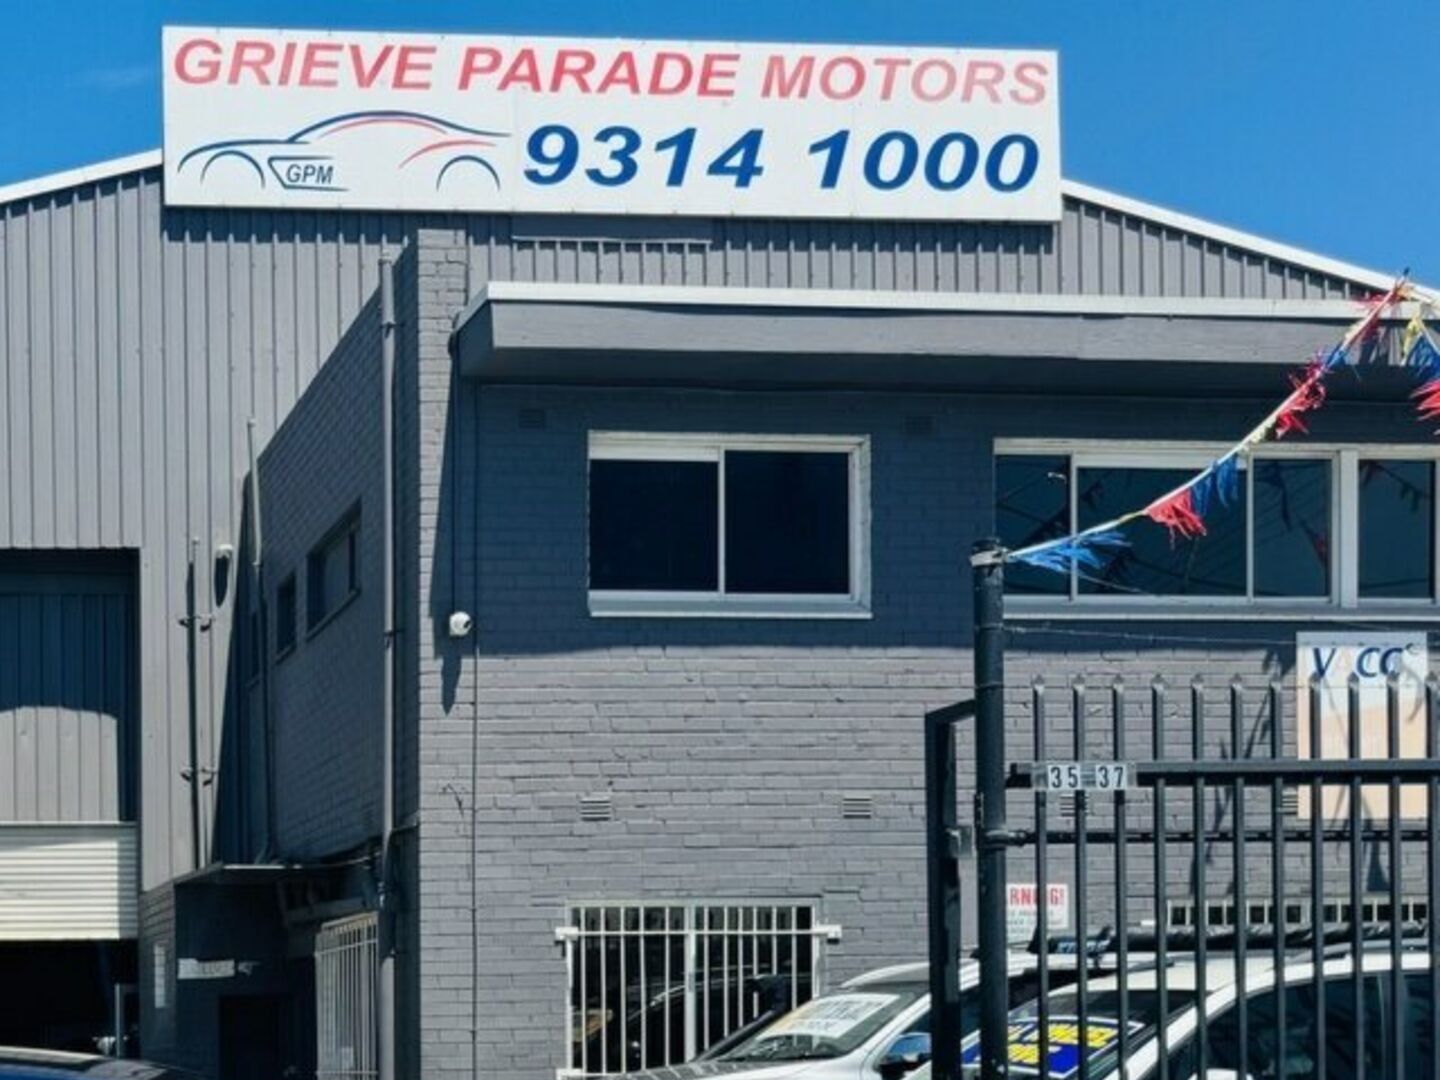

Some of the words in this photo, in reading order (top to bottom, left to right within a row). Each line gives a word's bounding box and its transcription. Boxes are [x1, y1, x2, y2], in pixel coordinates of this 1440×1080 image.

[173, 38, 437, 90] GRIEVE
[457, 46, 741, 98] PARADE
[760, 54, 1049, 106] MOTORS
[285, 163, 335, 185] GPM
[523, 123, 765, 189] 9314
[808, 129, 1040, 193] 1000
[1050, 766, 1078, 789] 35
[1098, 766, 1124, 789] 37
